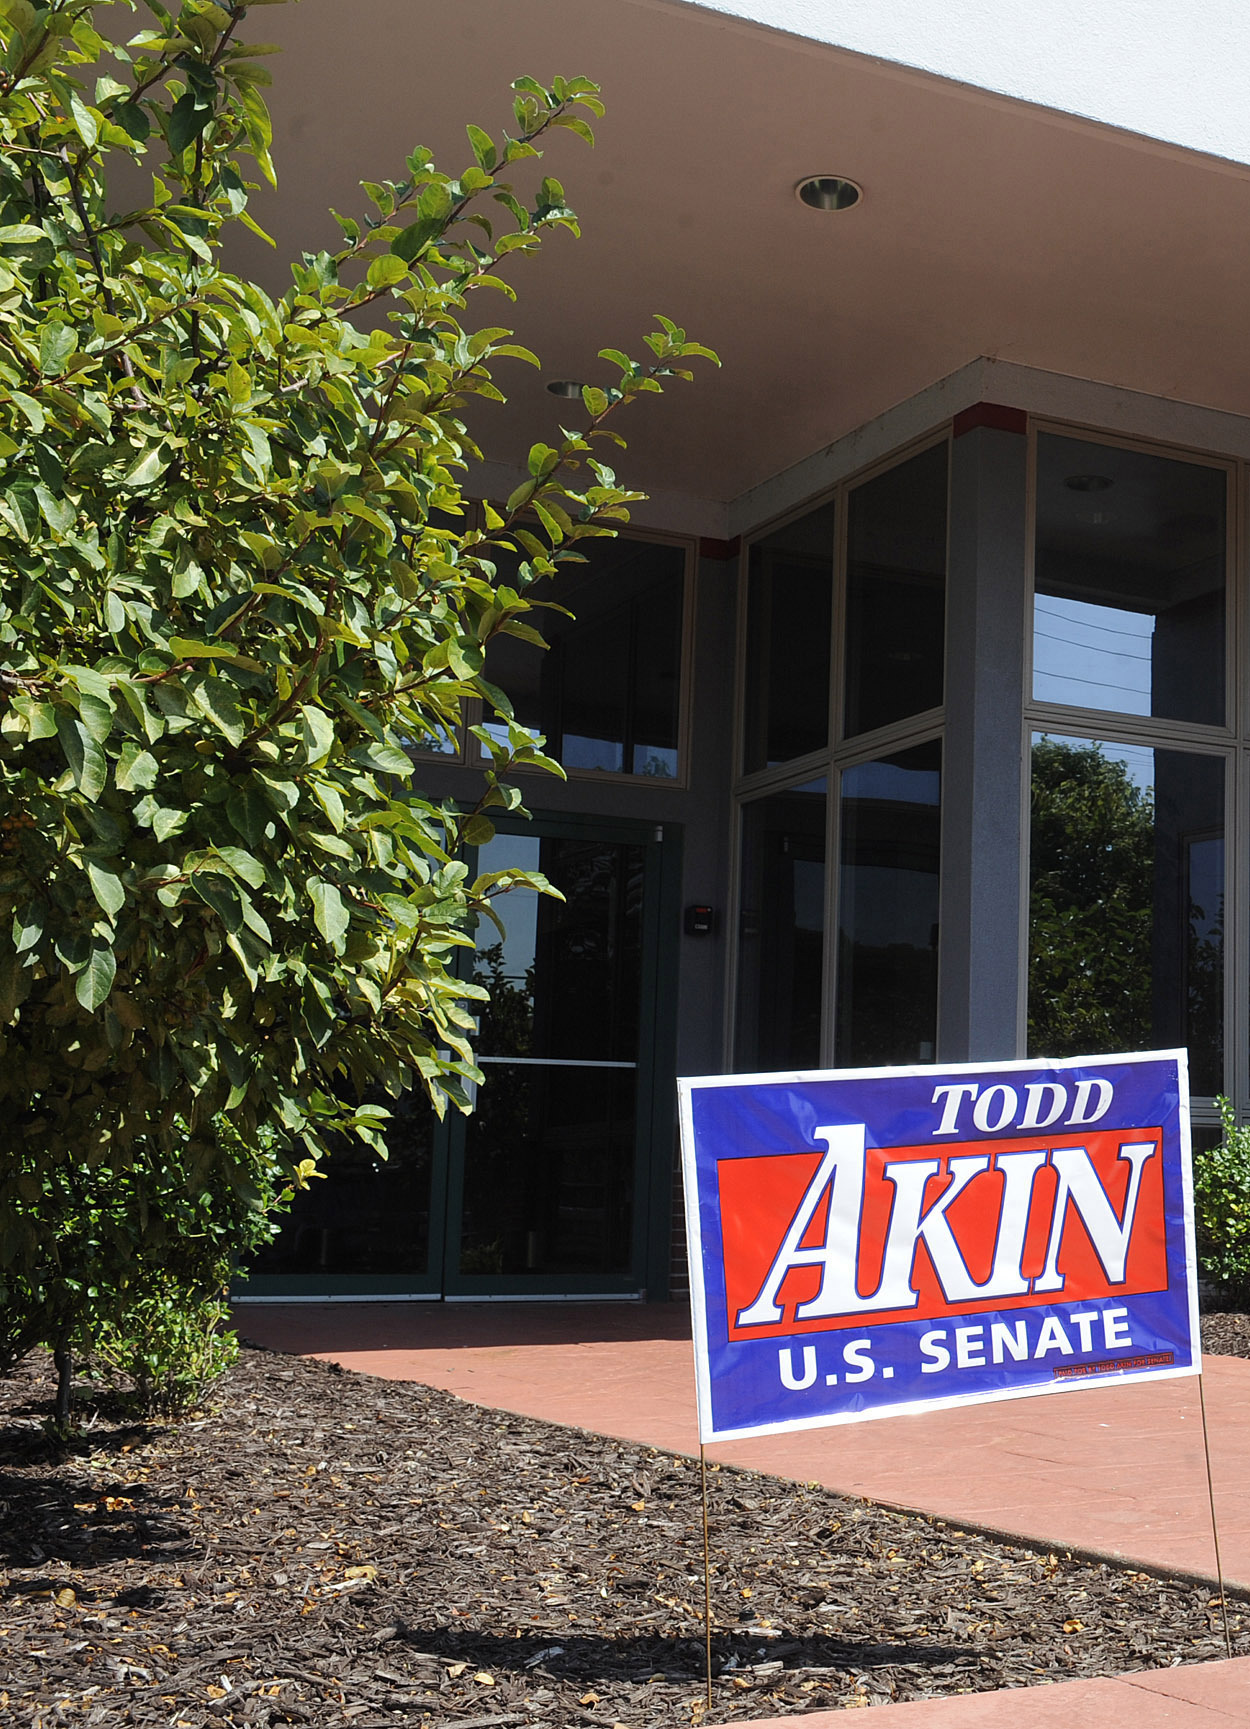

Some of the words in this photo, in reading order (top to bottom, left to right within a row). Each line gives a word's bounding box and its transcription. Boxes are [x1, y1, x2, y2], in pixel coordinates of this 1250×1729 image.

[931, 1079, 1114, 1136] TODD
[736, 1122, 1158, 1328] AKIN
[778, 1345, 894, 1391] U.S.
[919, 1307, 1133, 1374] SENATE
[1074, 1367, 1086, 1375] FOR
[1088, 1366, 1096, 1374] BY
[1098, 1363, 1114, 1372] TODD
[1117, 1361, 1132, 1370] AKIN
[1133, 1359, 1145, 1367] FOR
[1147, 1355, 1169, 1365] SENATE
